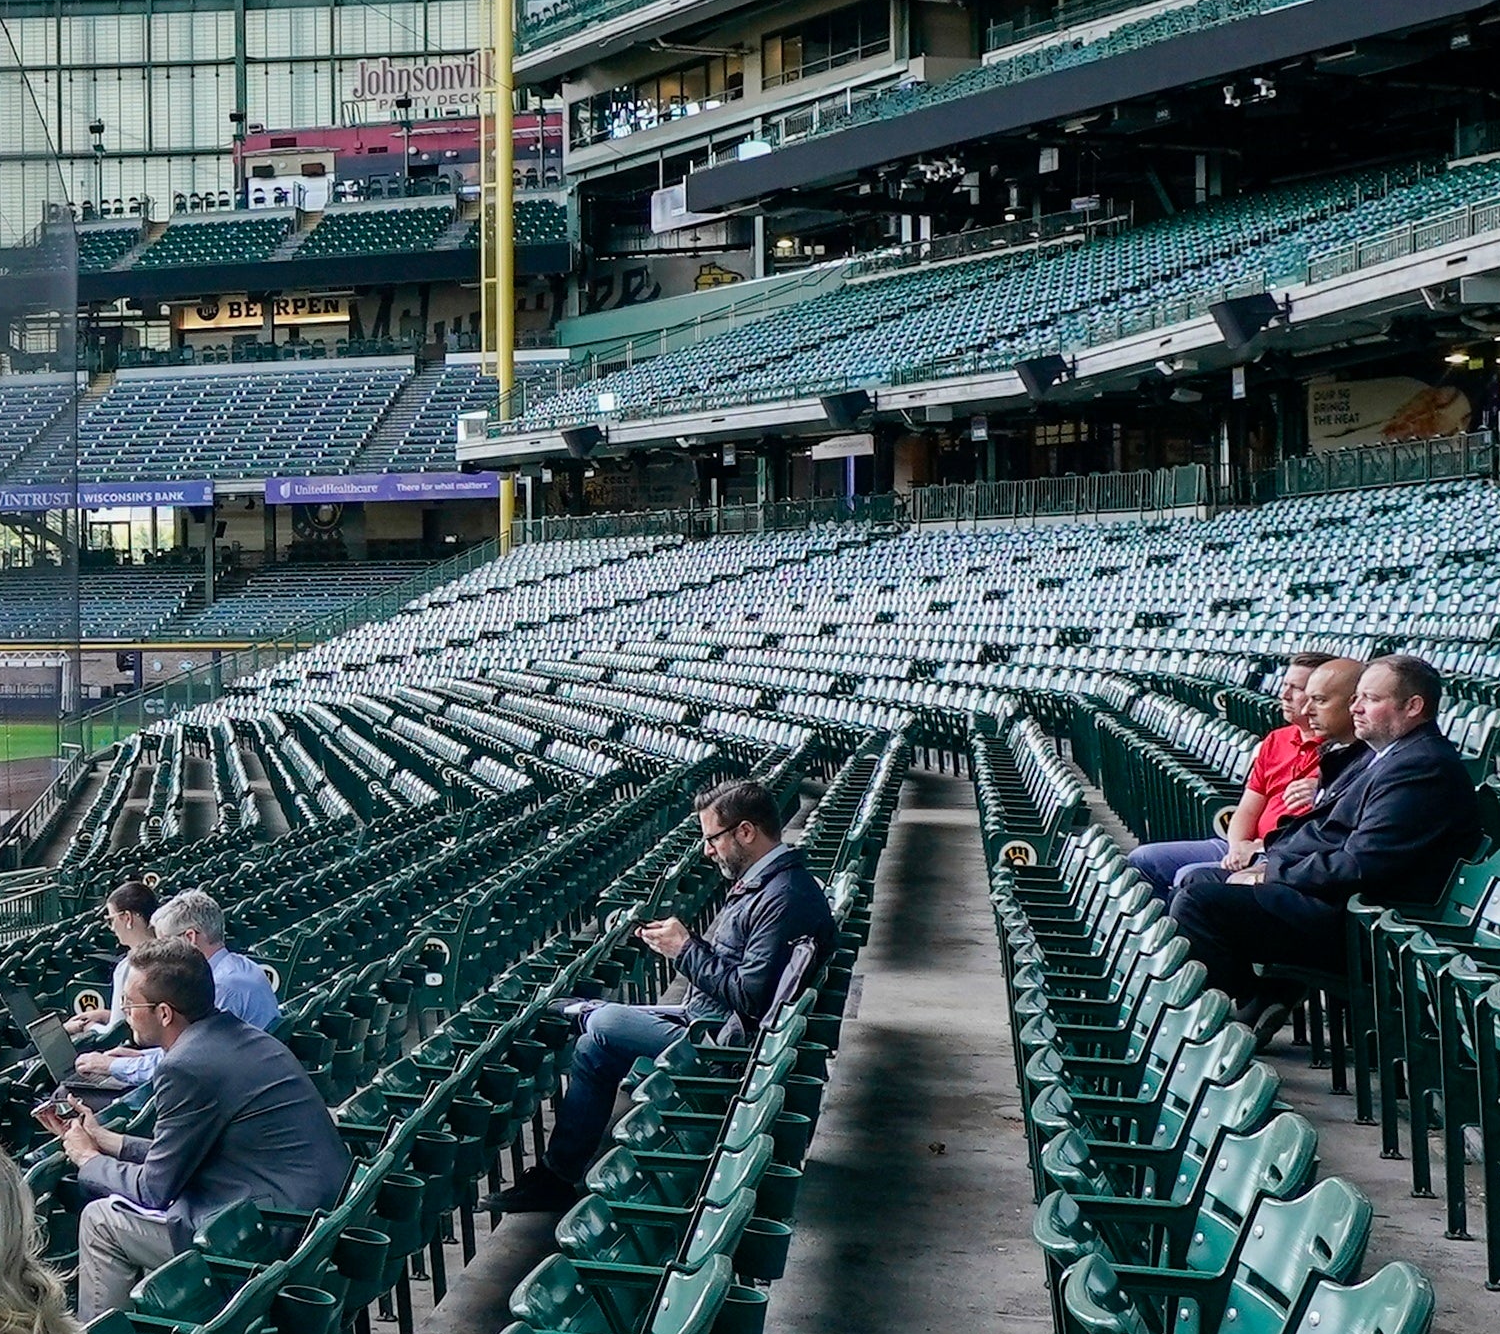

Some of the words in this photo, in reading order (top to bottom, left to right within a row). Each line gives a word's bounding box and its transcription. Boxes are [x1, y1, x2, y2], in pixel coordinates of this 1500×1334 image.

[353, 52, 496, 98] Johnsonvill
[379, 96, 431, 109] PATY
[438, 93, 481, 105] DECK
[228, 299, 339, 318] BERPEN
[1314, 414, 1332, 425] THE
[1334, 413, 1360, 423] HEAT
[295, 484, 378, 495] UnitedHealthcare
[397, 483, 419, 491] There
[421, 483, 433, 491] for
[435, 482, 454, 490] what
[456, 482, 487, 490] matters
[84, 492, 144, 504] WISCONSIN'S
[148, 491, 184, 502] BANK
